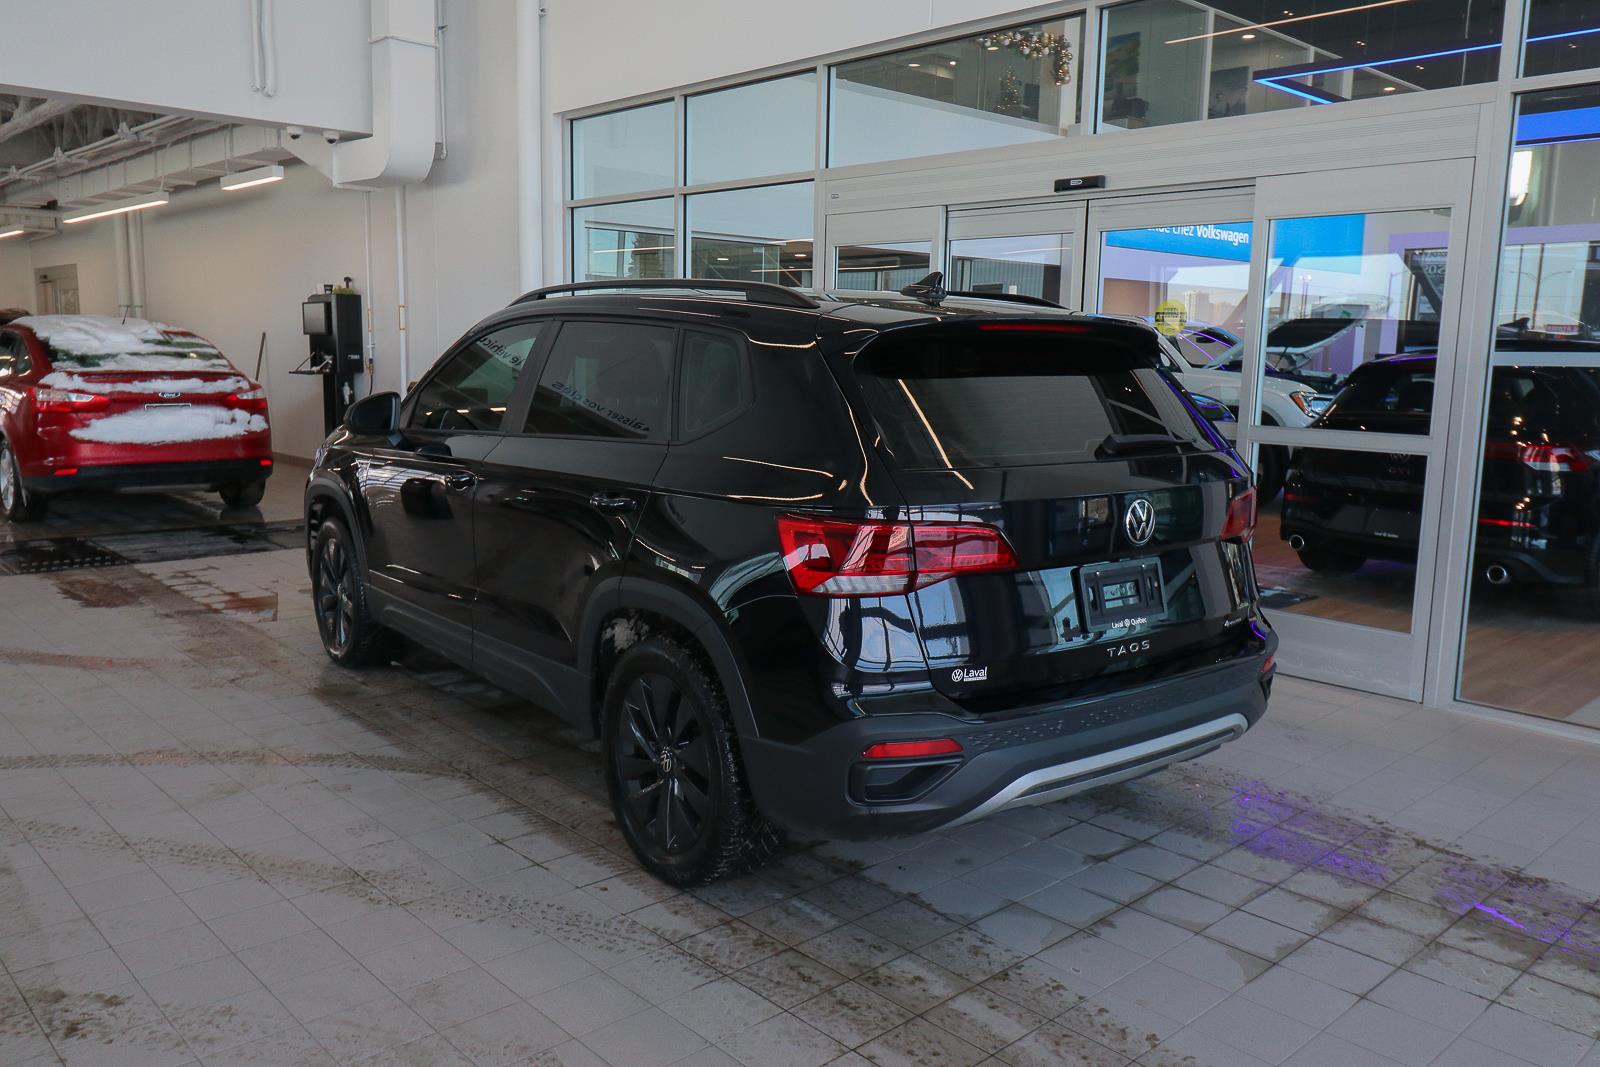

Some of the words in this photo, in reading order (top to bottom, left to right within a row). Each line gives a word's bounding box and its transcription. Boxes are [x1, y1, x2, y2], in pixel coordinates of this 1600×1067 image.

[1196, 224, 1249, 246] Volkswagen
[1107, 640, 1151, 658] TAOS
[963, 666, 988, 678] Laval
